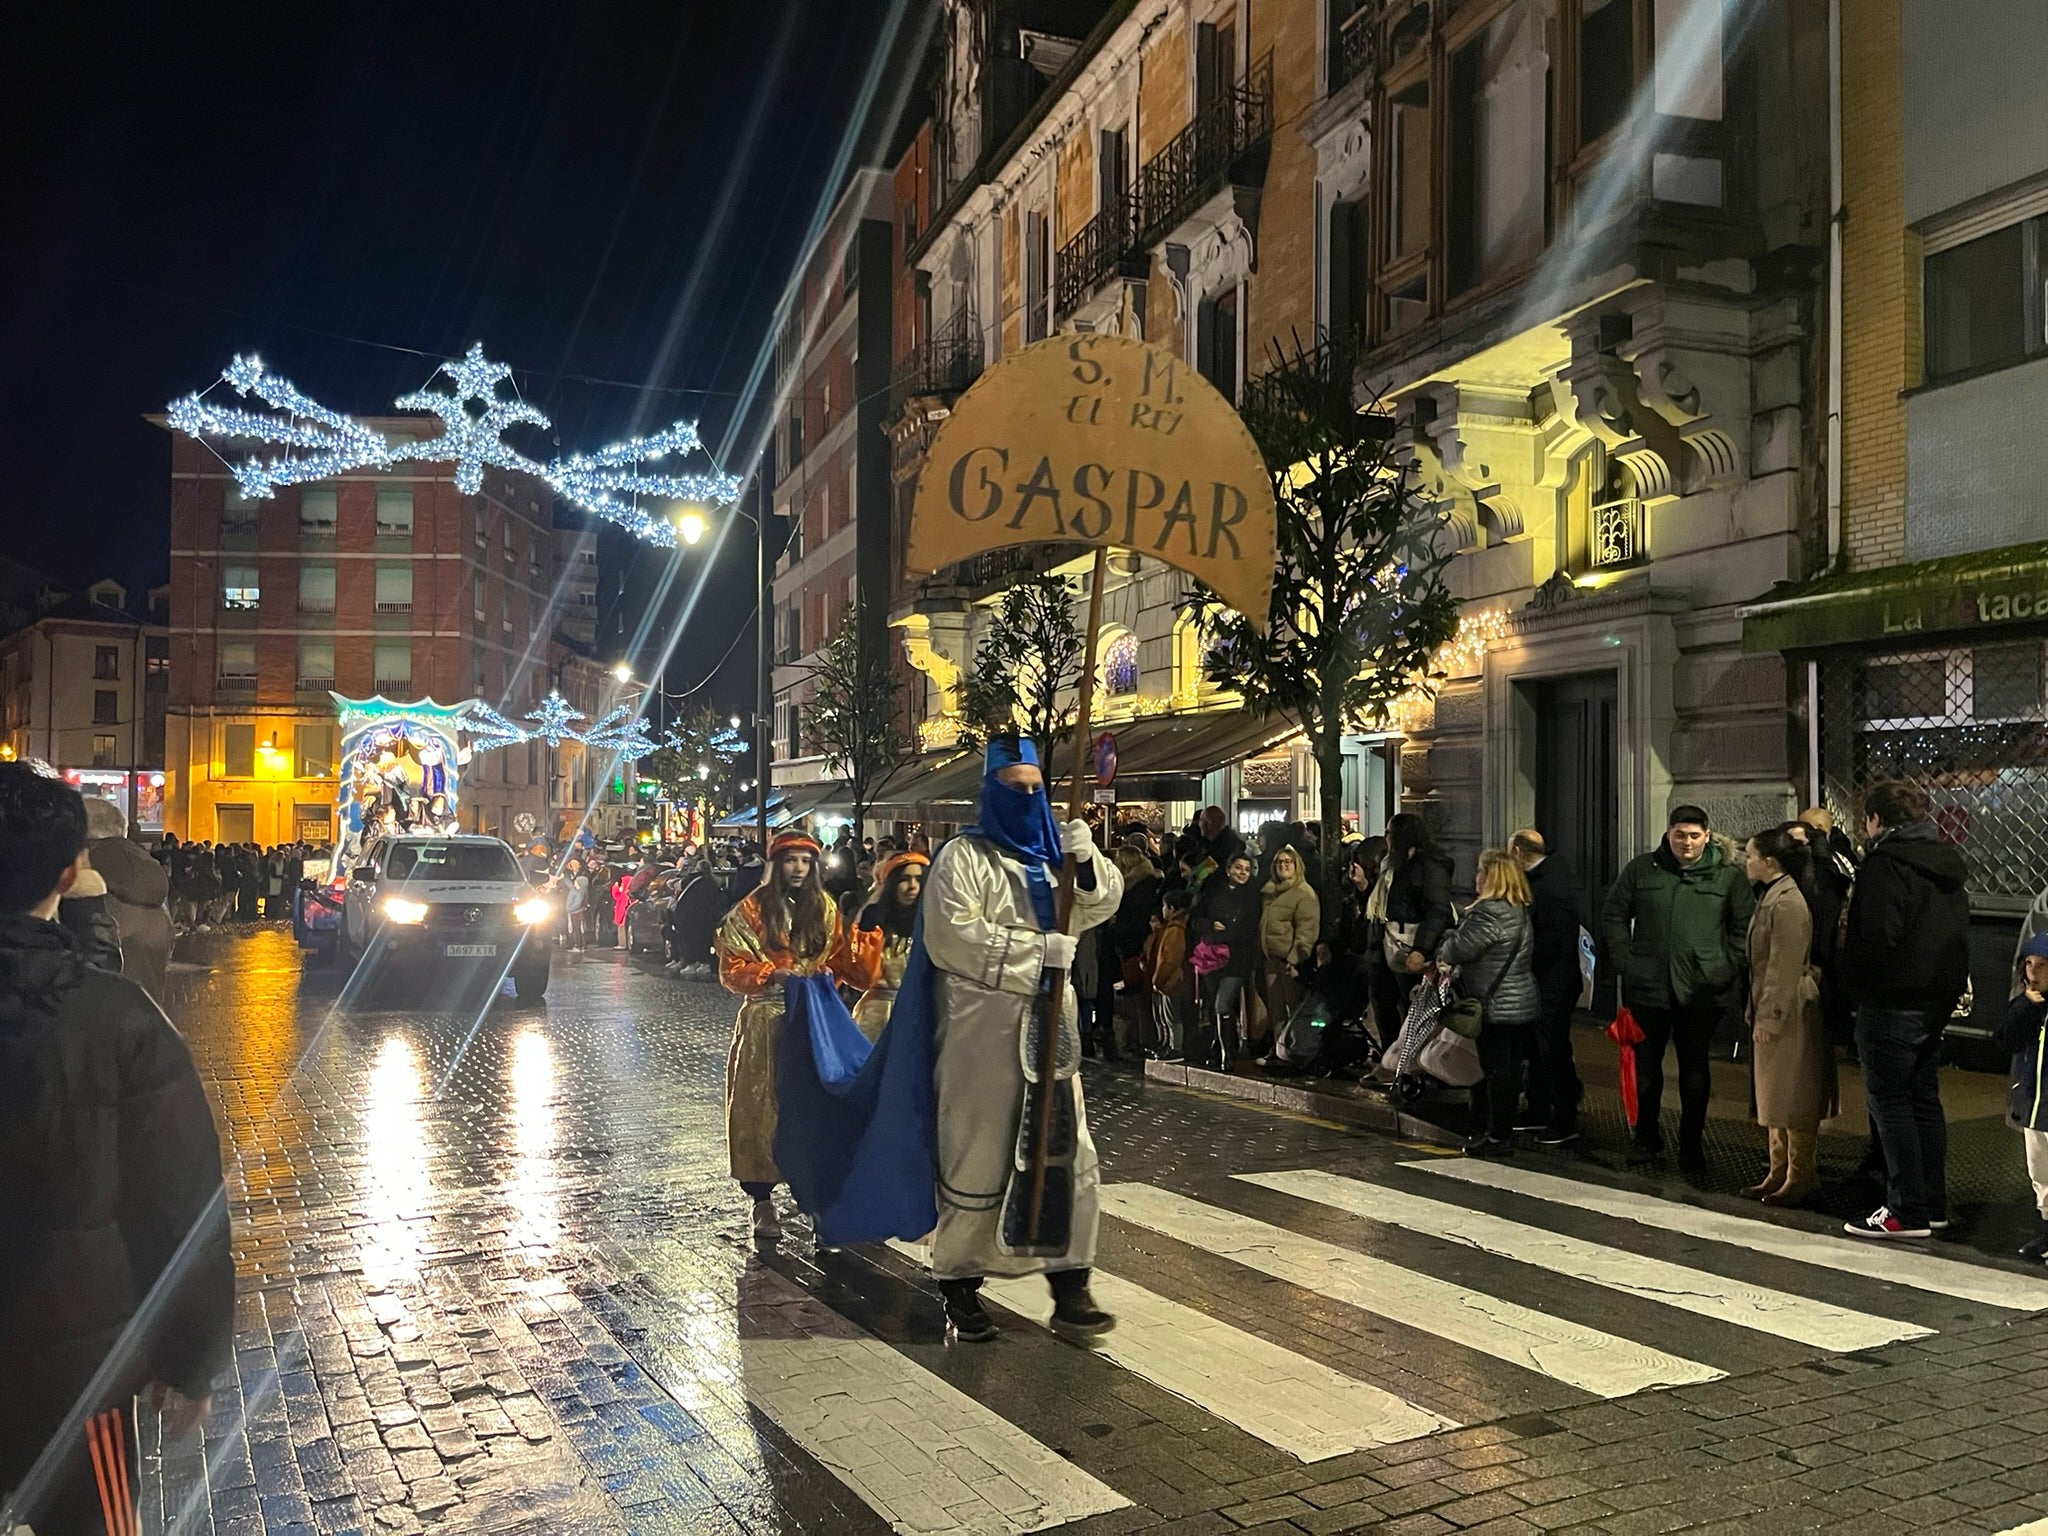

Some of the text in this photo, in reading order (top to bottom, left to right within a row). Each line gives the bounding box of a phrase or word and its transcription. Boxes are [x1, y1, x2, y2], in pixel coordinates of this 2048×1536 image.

[1069, 337, 1184, 405] S. M.
[948, 447, 1248, 561] GASPAR
[1883, 603, 1923, 632] La
